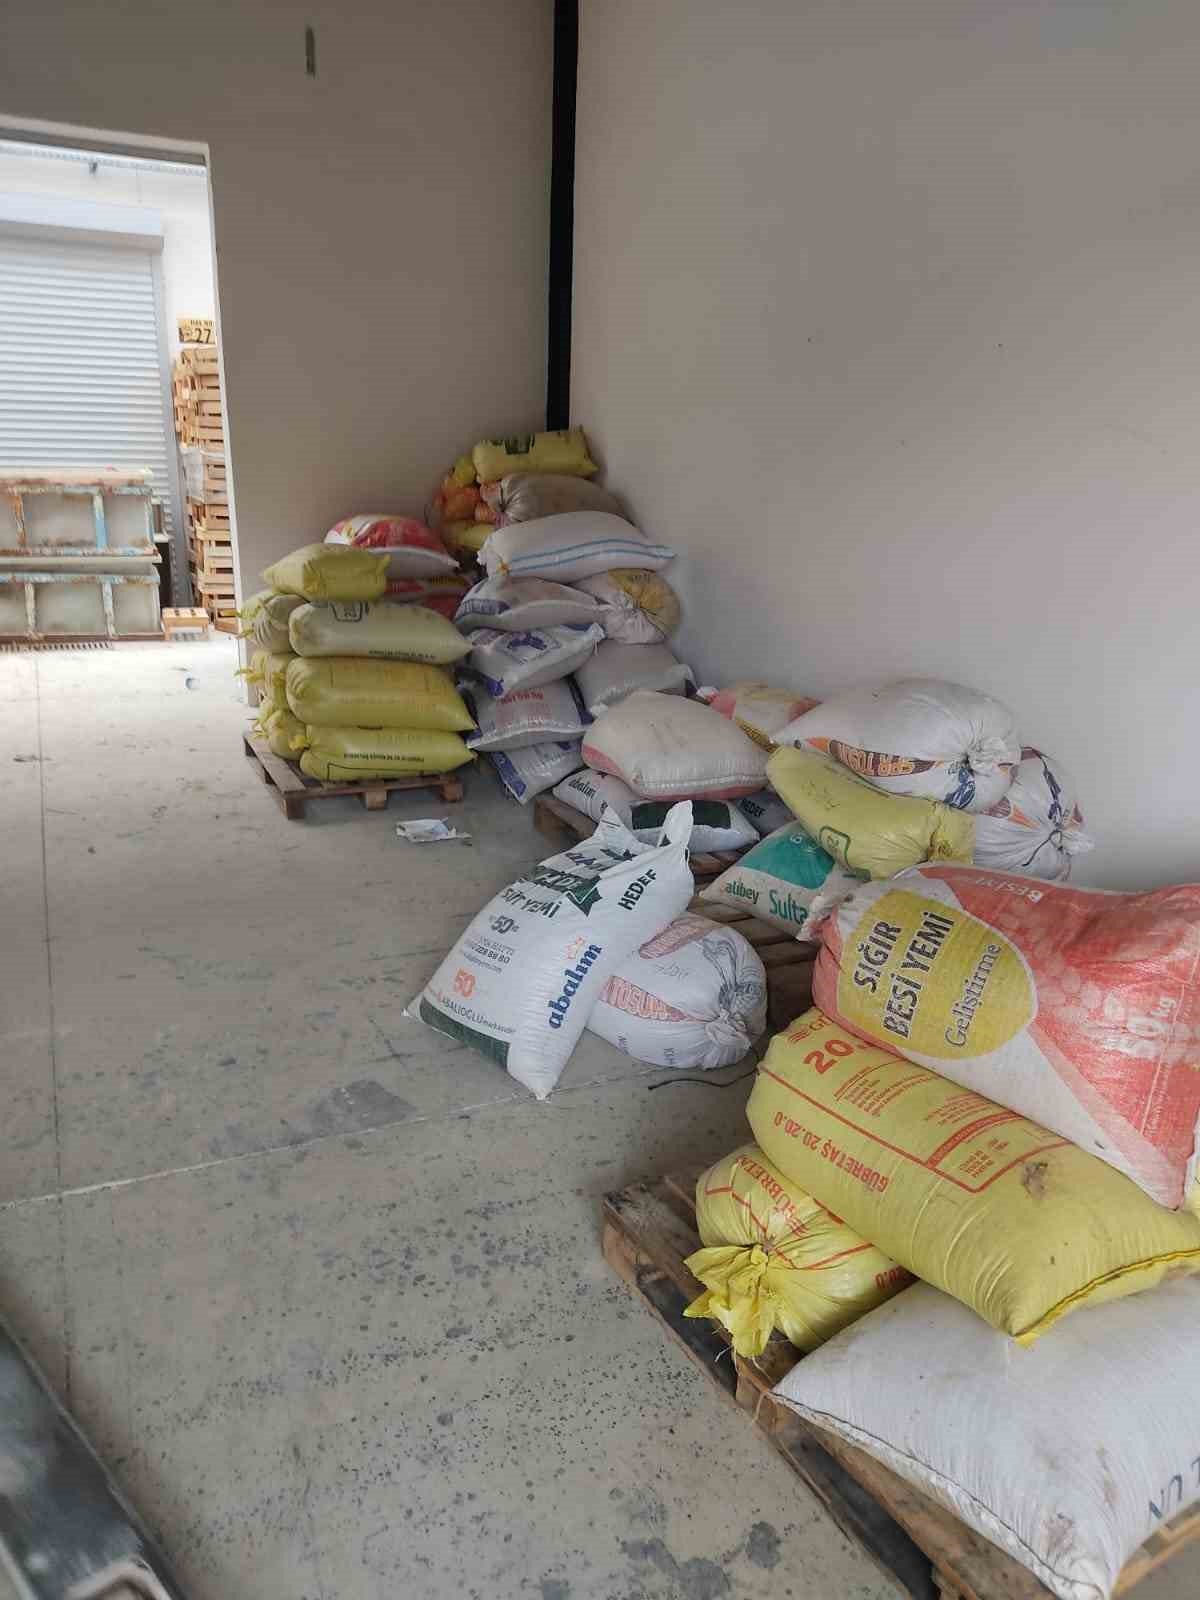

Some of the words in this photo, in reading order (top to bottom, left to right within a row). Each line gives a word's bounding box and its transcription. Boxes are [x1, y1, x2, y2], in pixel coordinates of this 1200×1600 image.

[194, 327, 211, 344] 27
[521, 896, 563, 918] YEMİ
[618, 868, 657, 911] HEDEF
[490, 915, 514, 934] 50
[901, 911, 954, 973] YEMİ
[853, 921, 902, 993] SIĞIR
[882, 973, 922, 1039] BESİ
[944, 944, 1001, 1047] Geliştirme
[774, 1111, 822, 1151] 20.20.0
[822, 1140, 890, 1193] GÜBRETAŞ
